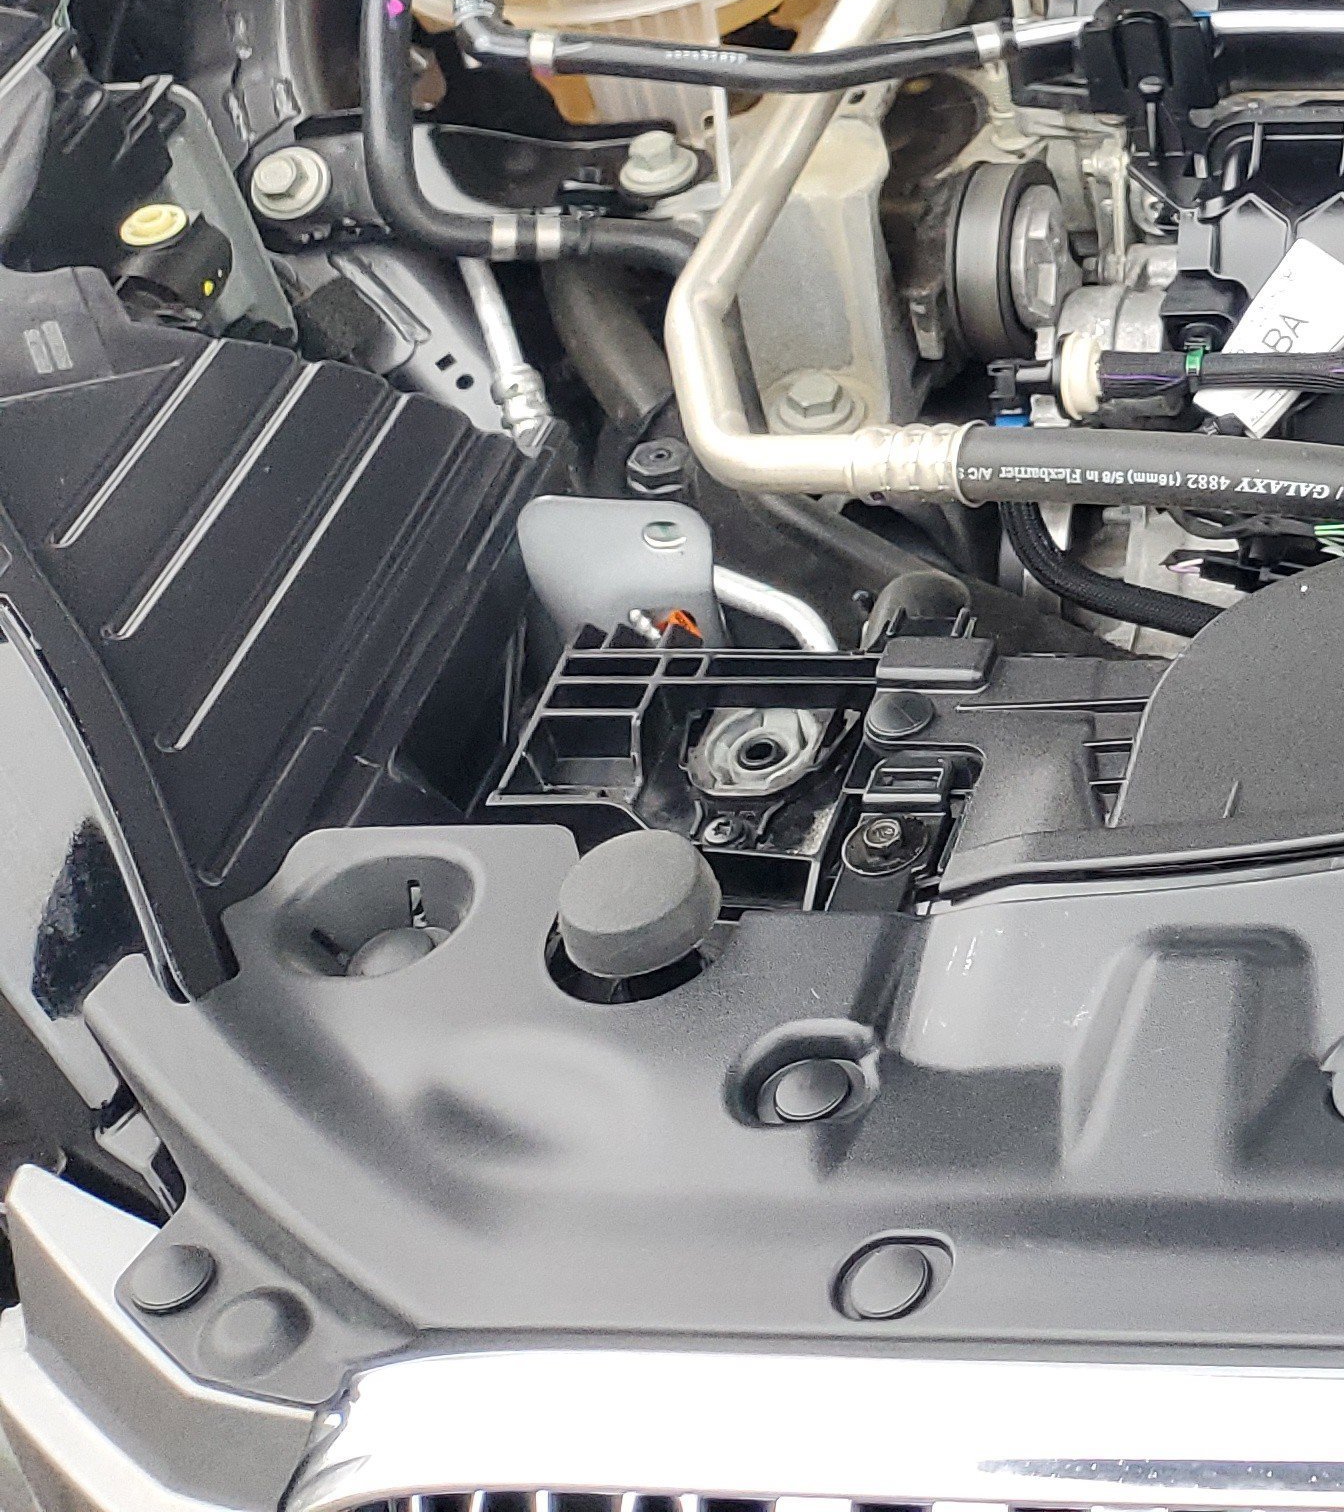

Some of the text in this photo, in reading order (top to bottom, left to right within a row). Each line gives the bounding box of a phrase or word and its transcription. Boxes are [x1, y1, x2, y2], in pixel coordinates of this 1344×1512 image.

[967, 467, 993, 481] A/C
[999, 466, 1083, 484] Flexbarrier
[1102, 469, 1124, 485] 5/8
[1127, 469, 1182, 487] (16mm)
[1186, 474, 1231, 491] 4882
[1235, 477, 1330, 499] GALAXY
